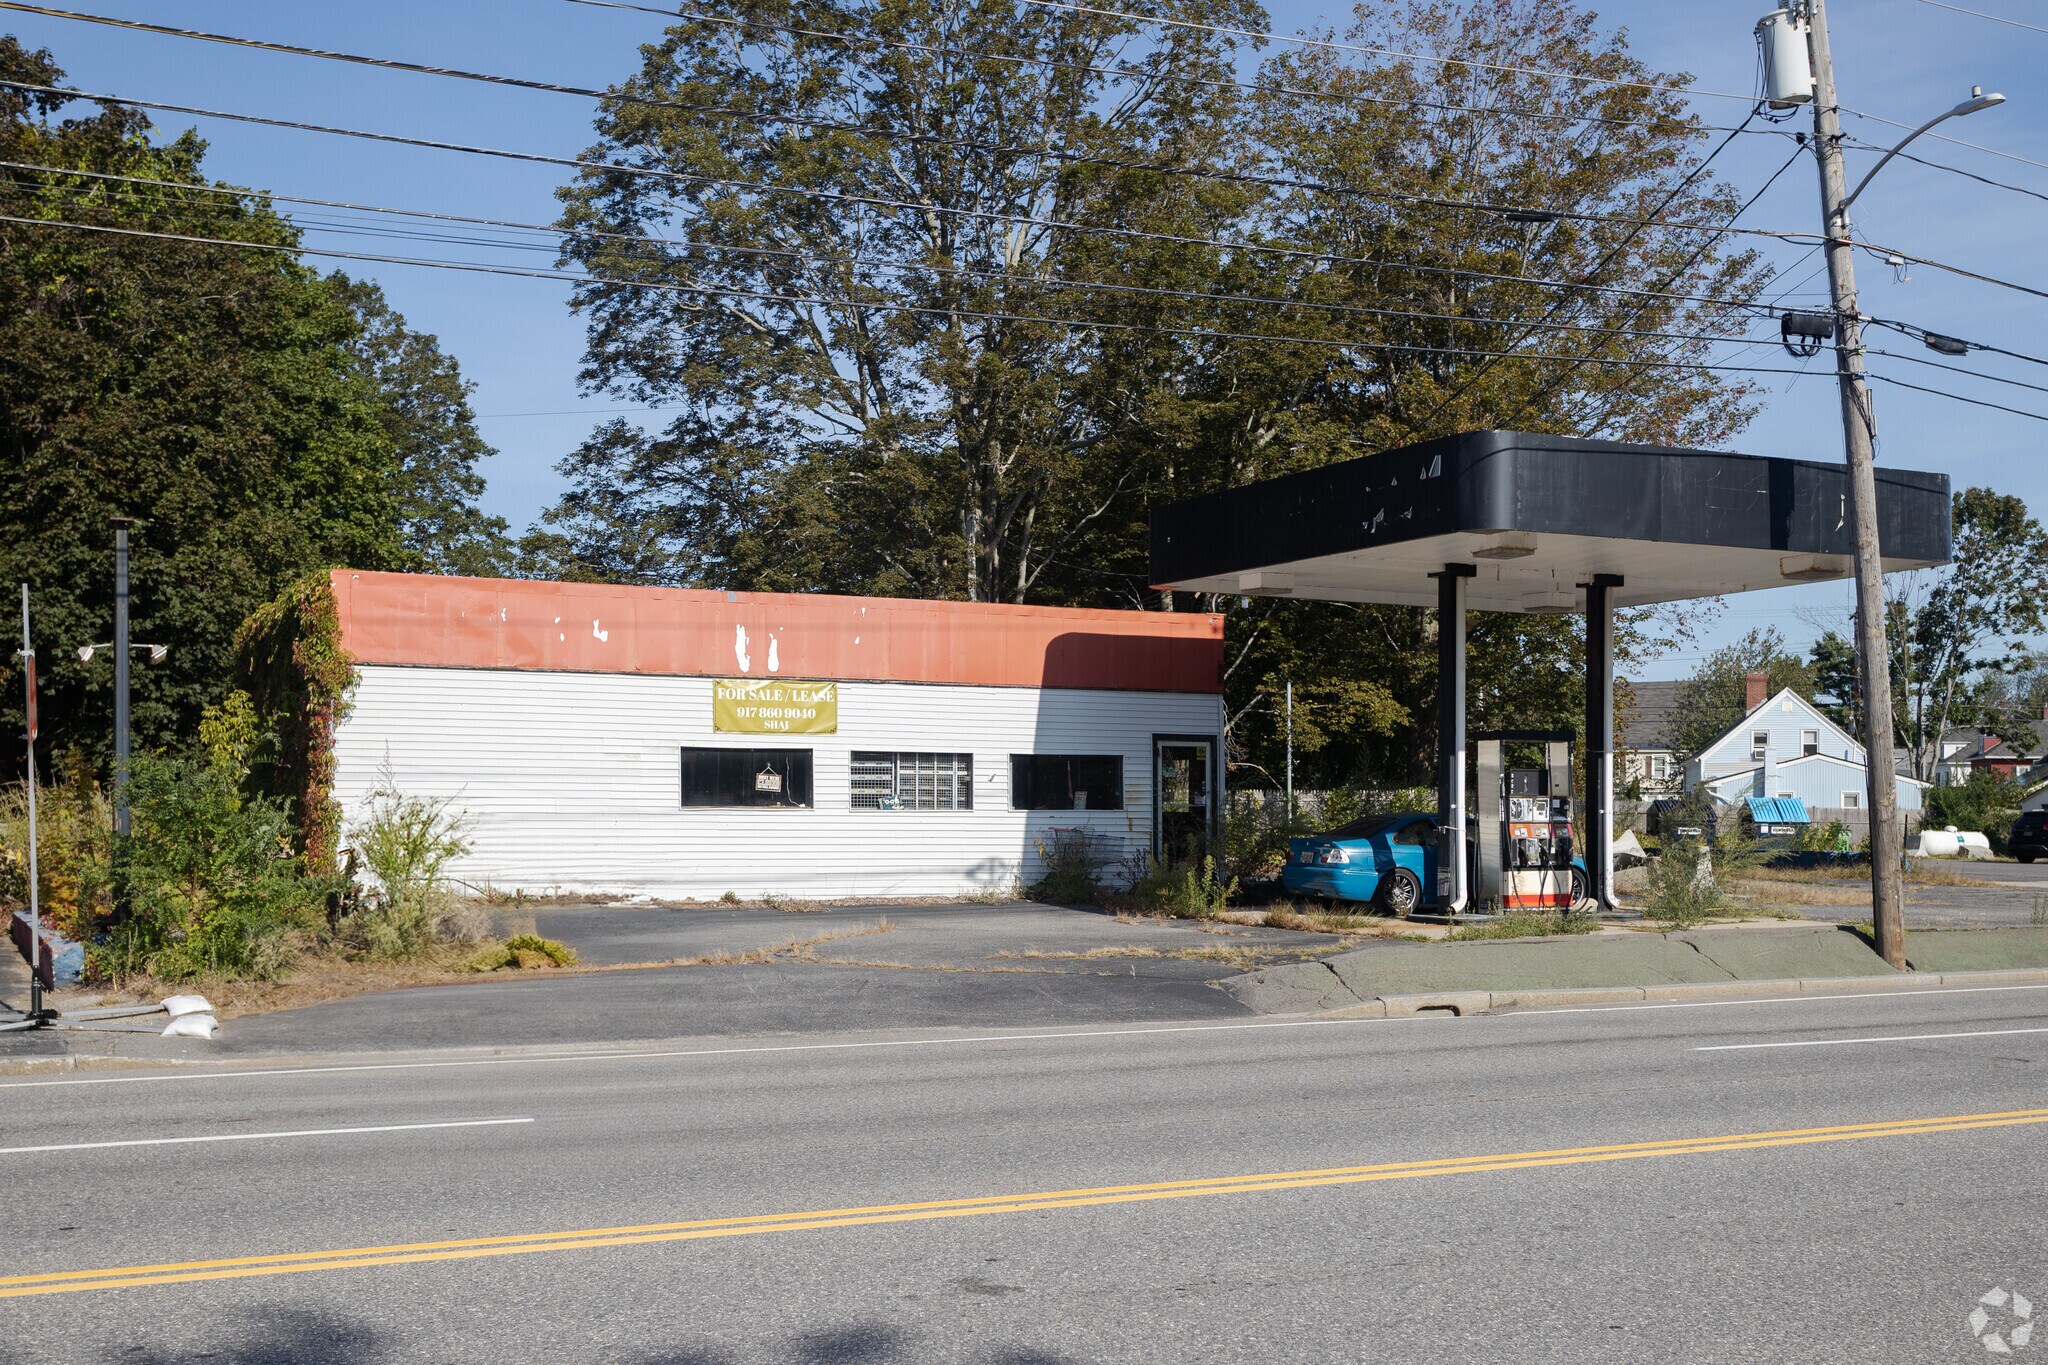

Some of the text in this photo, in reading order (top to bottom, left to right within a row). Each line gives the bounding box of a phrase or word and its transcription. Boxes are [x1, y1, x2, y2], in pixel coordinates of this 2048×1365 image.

[717, 688, 834, 702] FOR SALE / LEASE
[737, 707, 816, 719] 917 860 9040
[764, 720, 789, 730] SHAI
